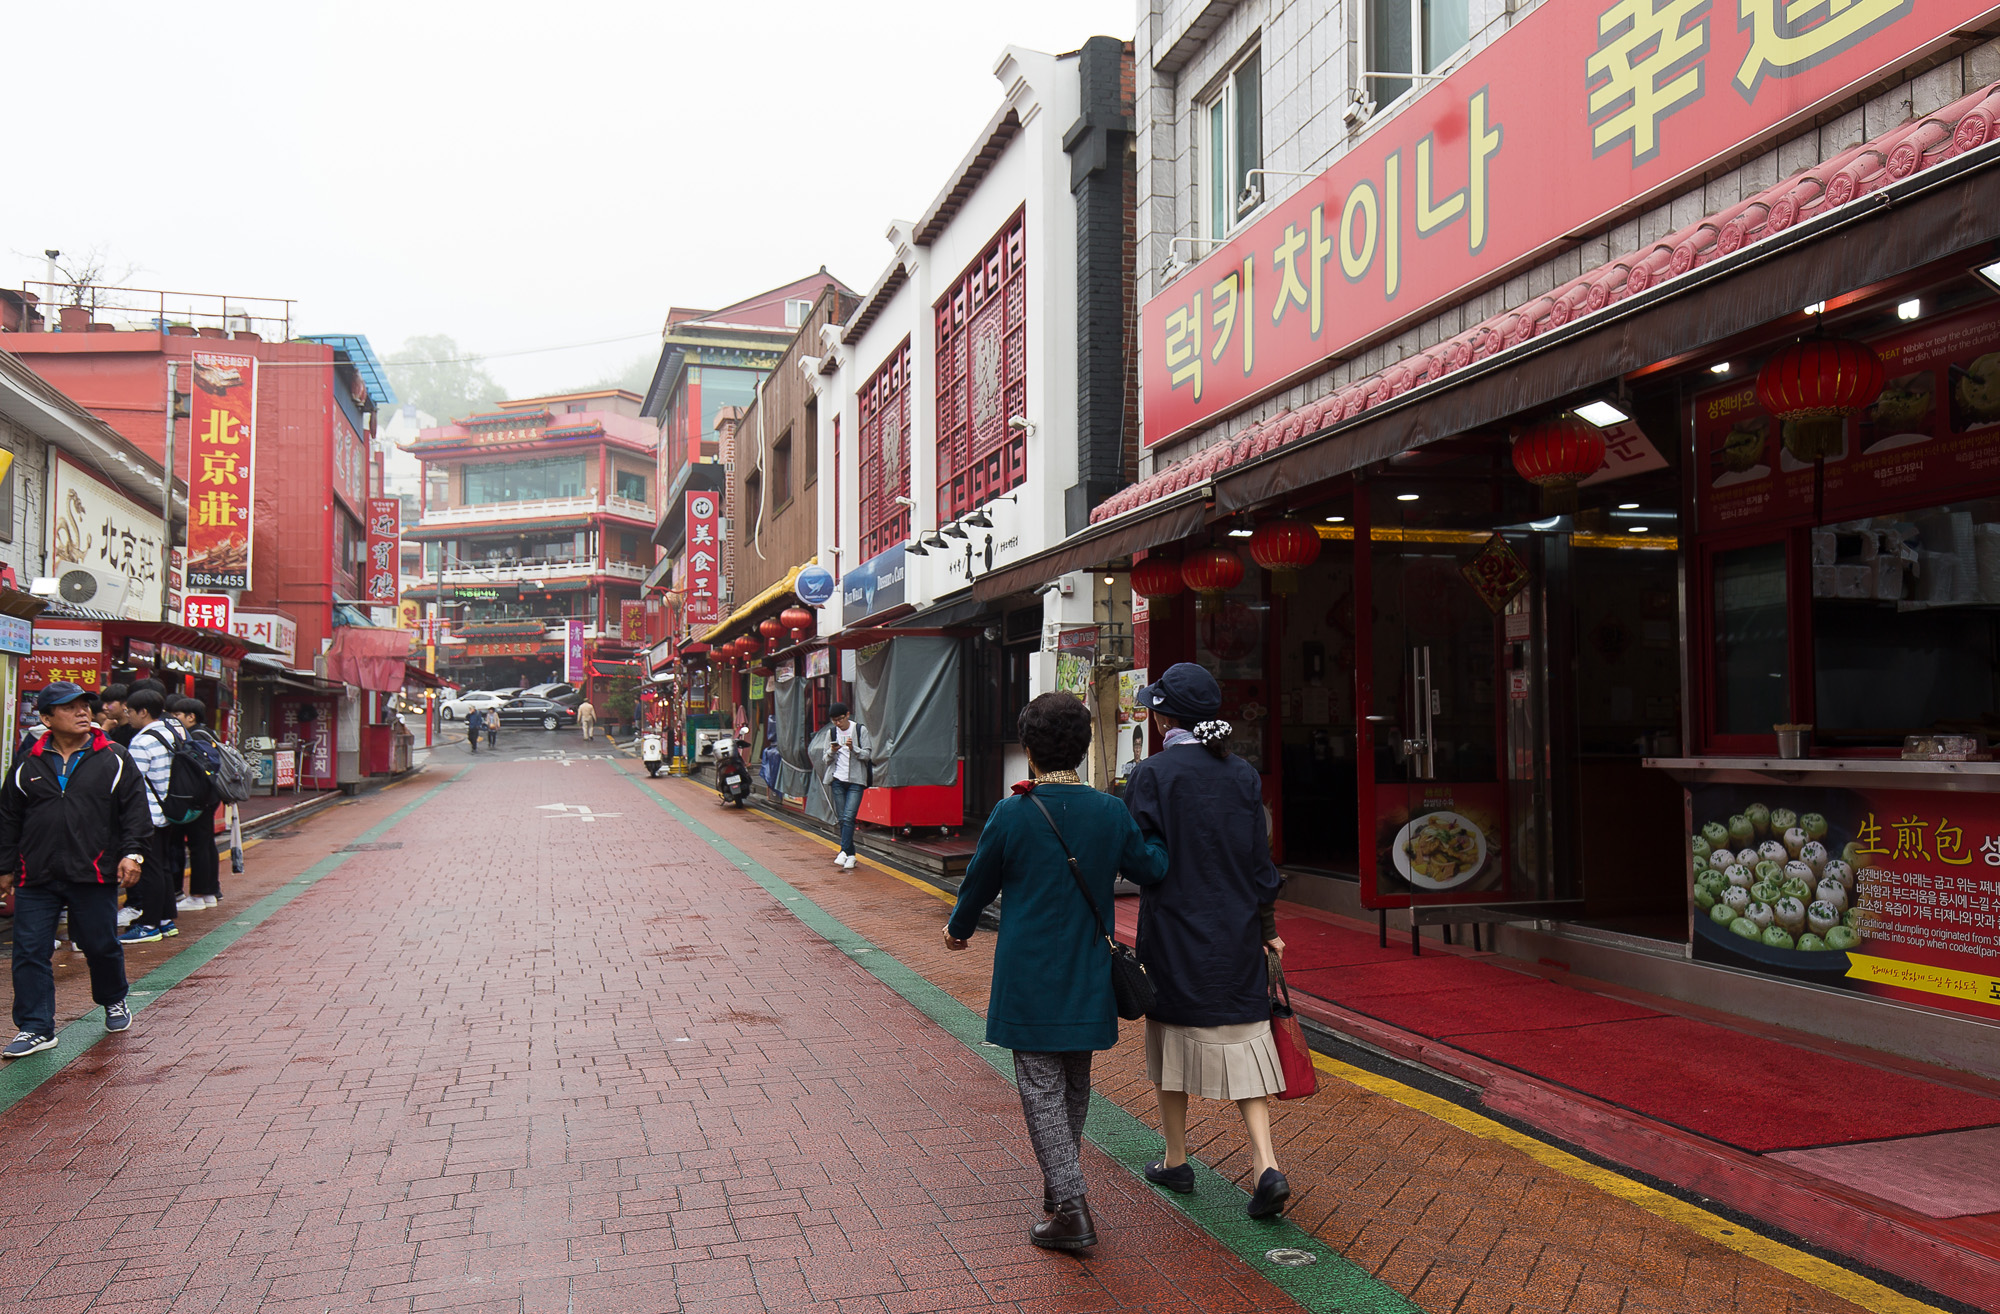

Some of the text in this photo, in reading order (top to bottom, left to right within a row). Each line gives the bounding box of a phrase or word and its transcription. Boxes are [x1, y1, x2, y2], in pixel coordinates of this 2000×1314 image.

[1166, 254, 1254, 402] 럭키
[1273, 87, 1502, 338] 차이나
[1903, 343, 1924, 355] Nibble
[1925, 339, 1933, 348] or
[1934, 335, 1947, 346] tear
[1949, 331, 1960, 341] the
[1962, 321, 1996, 337] dumpling
[1903, 355, 1914, 366] the
[1915, 352, 1930, 363] dish,
[1931, 347, 1946, 358] Wait
[1948, 343, 1957, 353] for
[1959, 339, 1971, 349] the
[1885, 347, 1900, 360] EAT
[1707, 390, 1755, 420] 성젠바오
[198, 407, 240, 527] 北京莊
[1895, 460, 1924, 476] 뜨거우니
[190, 573, 245, 587] 766-4455
[187, 602, 226, 628] 홍두병
[47, 668, 97, 685] 홍두병
[1855, 811, 1974, 866] 生煎包
[1856, 867, 1901, 886] 성젠바오는
[1902, 872, 1932, 889] 아래는
[1934, 875, 1954, 891] 굽고
[1957, 877, 1977, 894] 위는
[1857, 882, 1890, 900] 바삭함과
[1892, 887, 1937, 906] 부드러움을
[1939, 892, 1968, 909] 동시에
[1970, 896, 1989, 912] 느낄
[1857, 897, 1883, 915] 고소한
[1885, 901, 1911, 918] 육즙이
[1913, 905, 1932, 921] 가득
[1935, 908, 1973, 926] 터져나와
[1974, 912, 1996, 929] 맛과
[1857, 915, 1893, 931] Traditional
[1895, 921, 1930, 938] dumpling
[1931, 927, 1971, 942] originated
[1972, 932, 1992, 945] from
[1857, 926, 1870, 938] that
[1872, 930, 1890, 941] melts
[1891, 932, 1905, 944] into
[1907, 935, 1925, 948] soup
[1927, 938, 1947, 950] when
[1871, 964, 1899, 978] 집에서도
[1902, 968, 1925, 983] 맛있게
[1927, 974, 1942, 988] 드실
[1944, 977, 1951, 989] 수
[1954, 979, 1978, 994] 있도록
